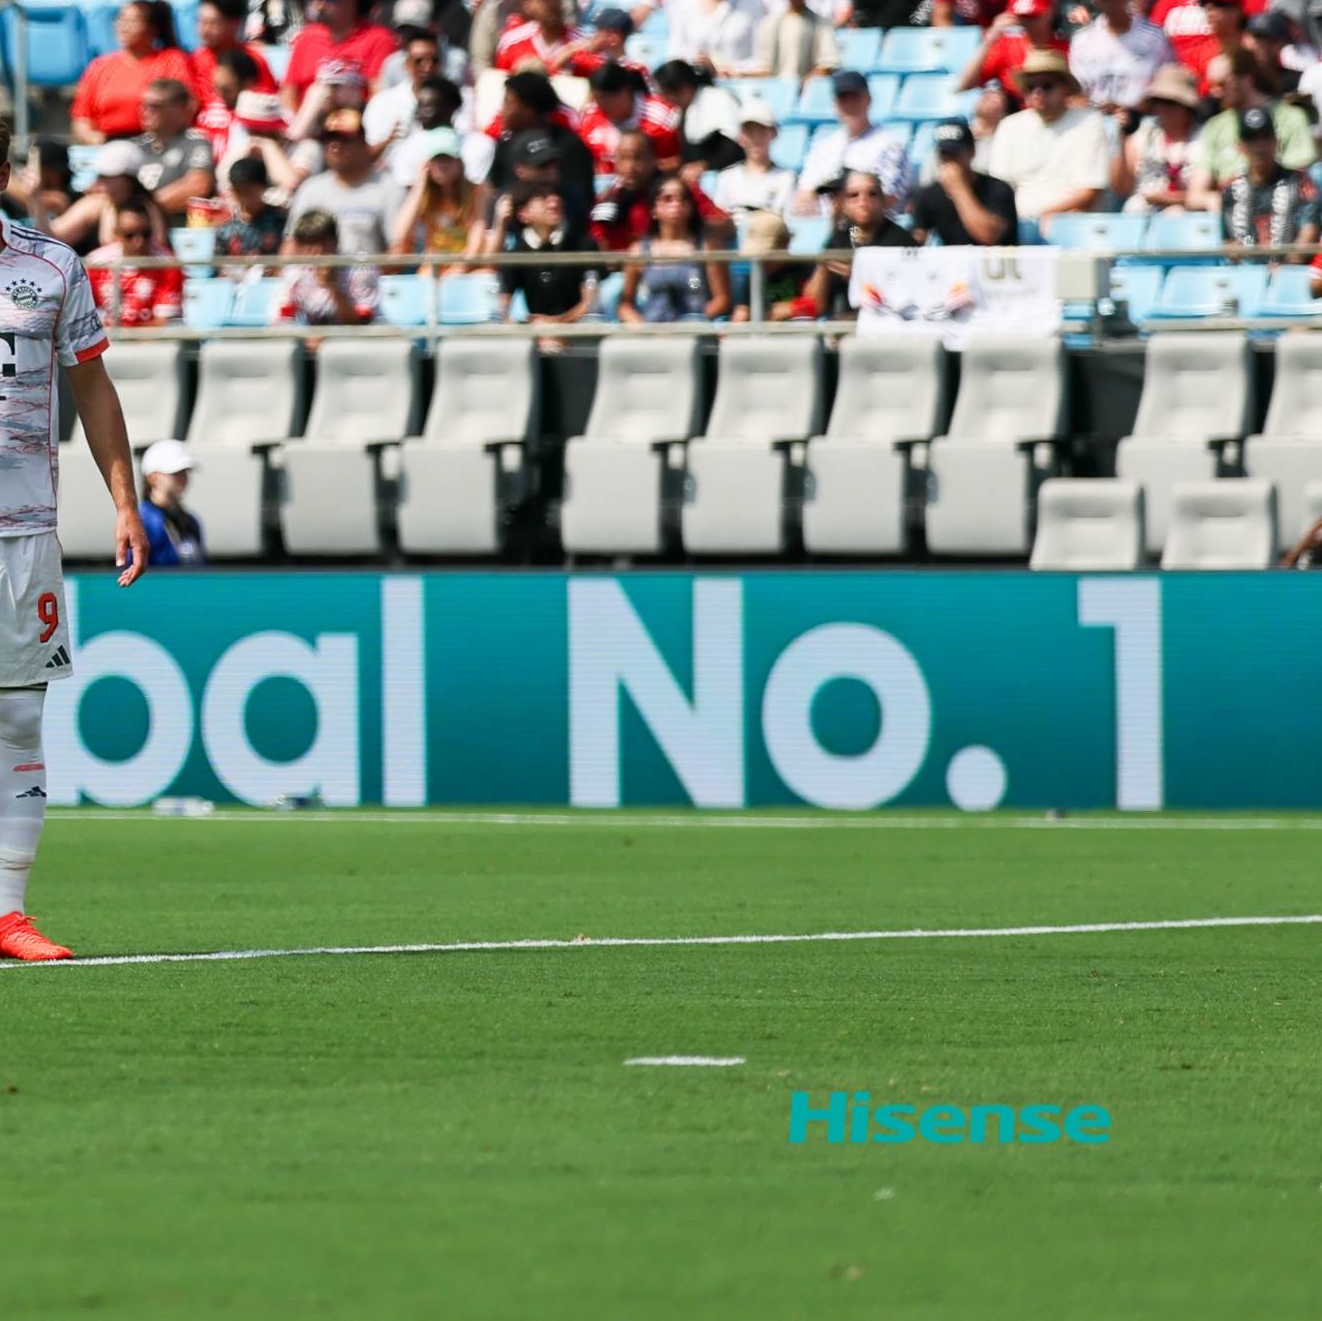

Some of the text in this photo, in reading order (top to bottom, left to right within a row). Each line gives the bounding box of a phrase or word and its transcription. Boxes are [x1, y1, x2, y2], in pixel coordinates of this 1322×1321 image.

[37, 591, 60, 644] 9
[567, 577, 1008, 812] No.
[1076, 577, 1164, 812] 1
